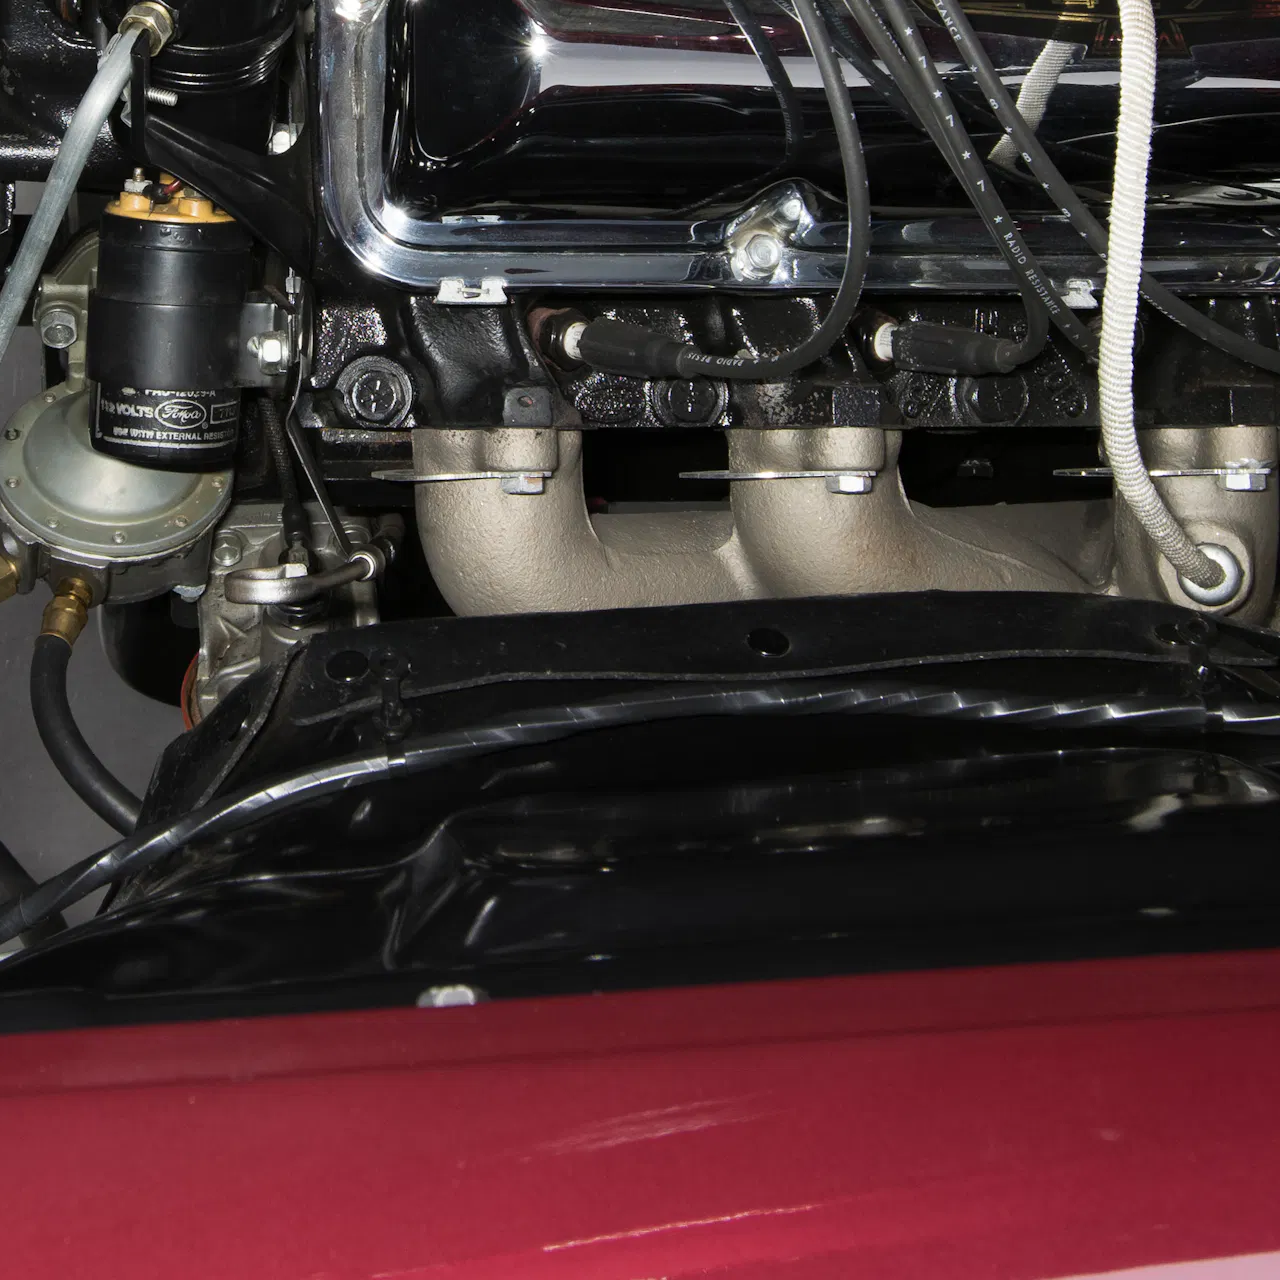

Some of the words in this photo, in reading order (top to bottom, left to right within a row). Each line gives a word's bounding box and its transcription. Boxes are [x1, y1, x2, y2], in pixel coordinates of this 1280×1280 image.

[1022, 152, 1032, 163] 8
[919, 55, 928, 68] 7
[946, 114, 955, 127] 7
[976, 179, 986, 192] 7
[1004, 231, 1026, 265] RADIO
[1025, 269, 1061, 316] RESISTANCE
[116, 402, 154, 418] VOLTS
[130, 428, 154, 439] WITH
[156, 431, 202, 441] EXTERNAL
